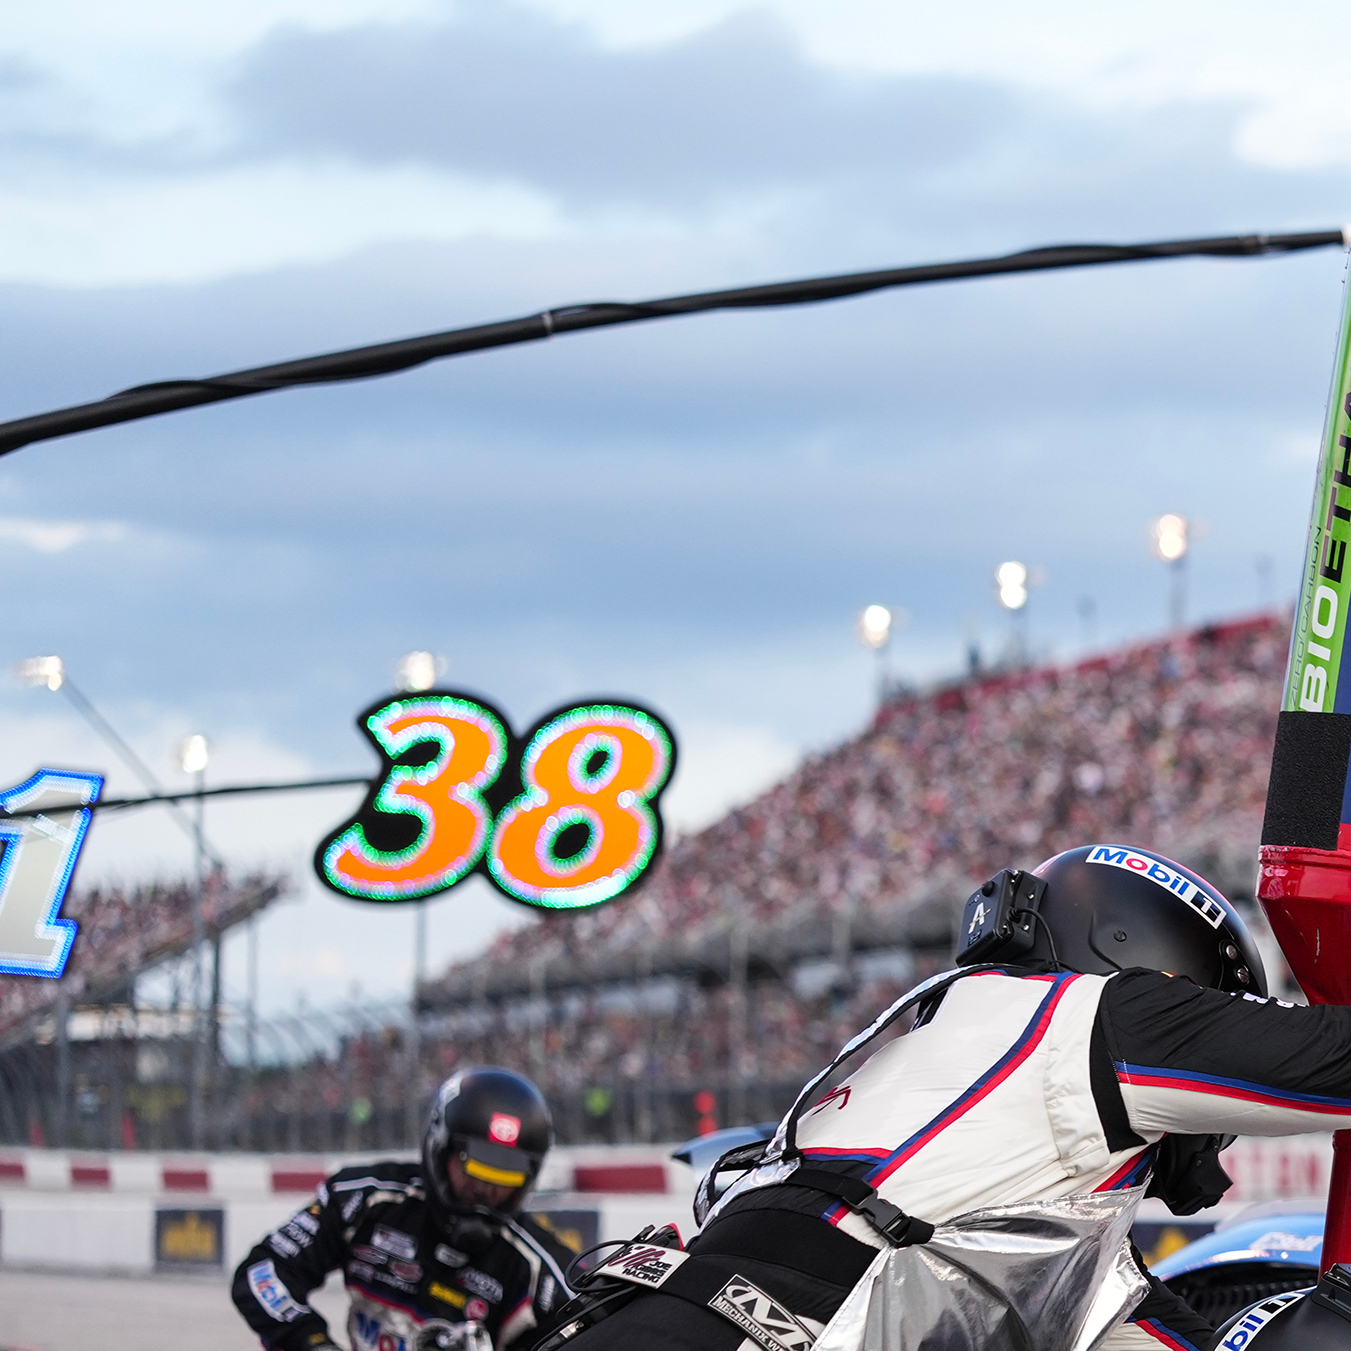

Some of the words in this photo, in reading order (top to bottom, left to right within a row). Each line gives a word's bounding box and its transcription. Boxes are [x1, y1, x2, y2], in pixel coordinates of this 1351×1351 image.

[320, 694, 672, 910] 38
[1092, 847, 1190, 897] Mobil
[1199, 895, 1217, 914] 1
[649, 1260, 673, 1271] JOE
[711, 1295, 768, 1343] MECHANIX
